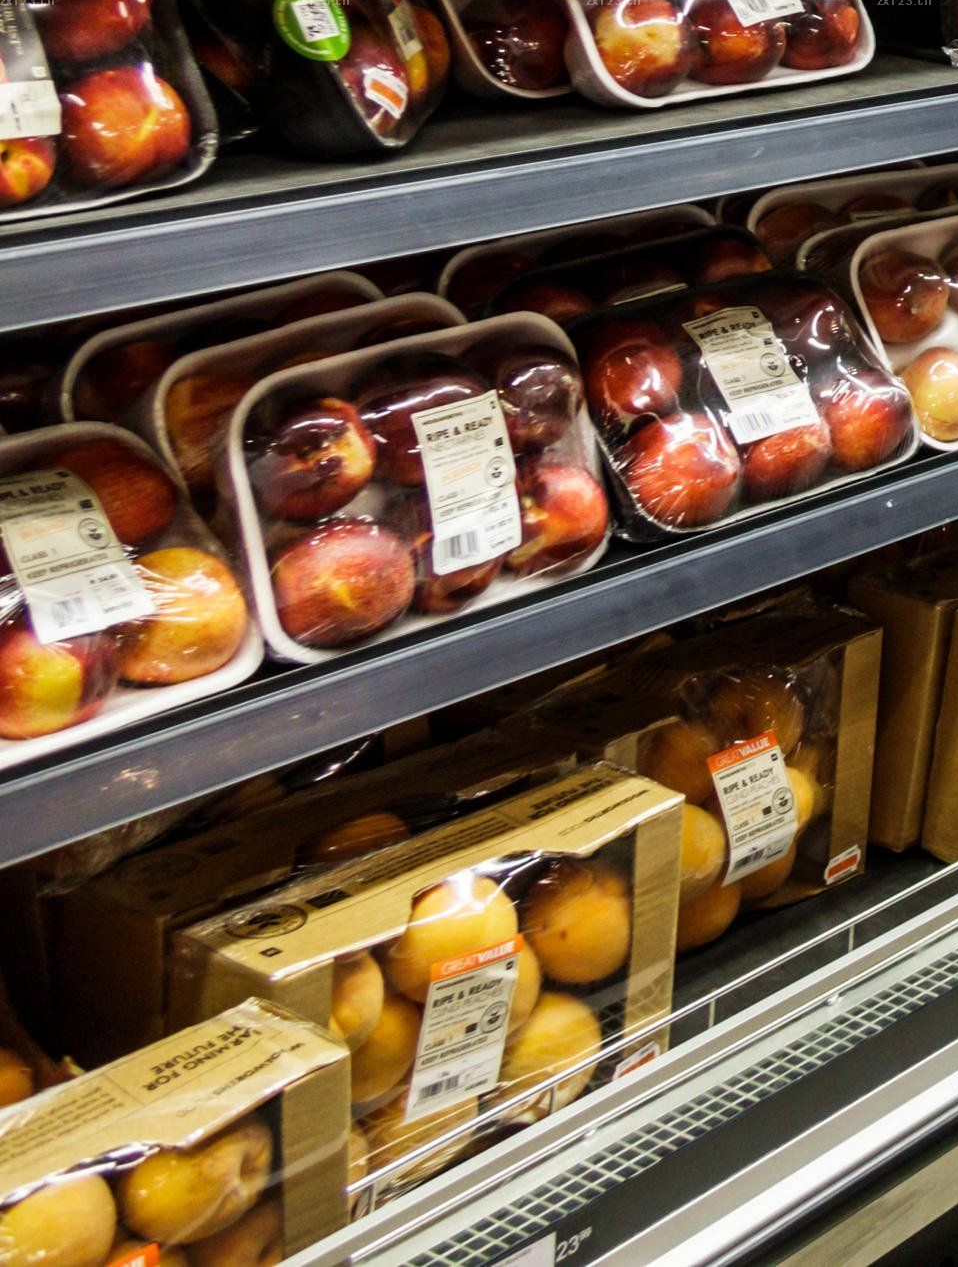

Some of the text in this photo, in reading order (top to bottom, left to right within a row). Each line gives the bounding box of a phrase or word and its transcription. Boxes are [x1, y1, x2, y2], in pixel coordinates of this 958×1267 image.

[426, 430, 449, 443] RIPE
[464, 417, 494, 432] READY
[723, 783, 741, 796] RIPE
[749, 767, 775, 784] READY
[441, 940, 516, 975] GREATVALUE
[432, 994, 454, 1009] RIPE
[456, 990, 466, 1001] &
[467, 977, 505, 996] READY
[152, 1037, 215, 1076] FUTURE
[145, 1067, 184, 1094] FOR
